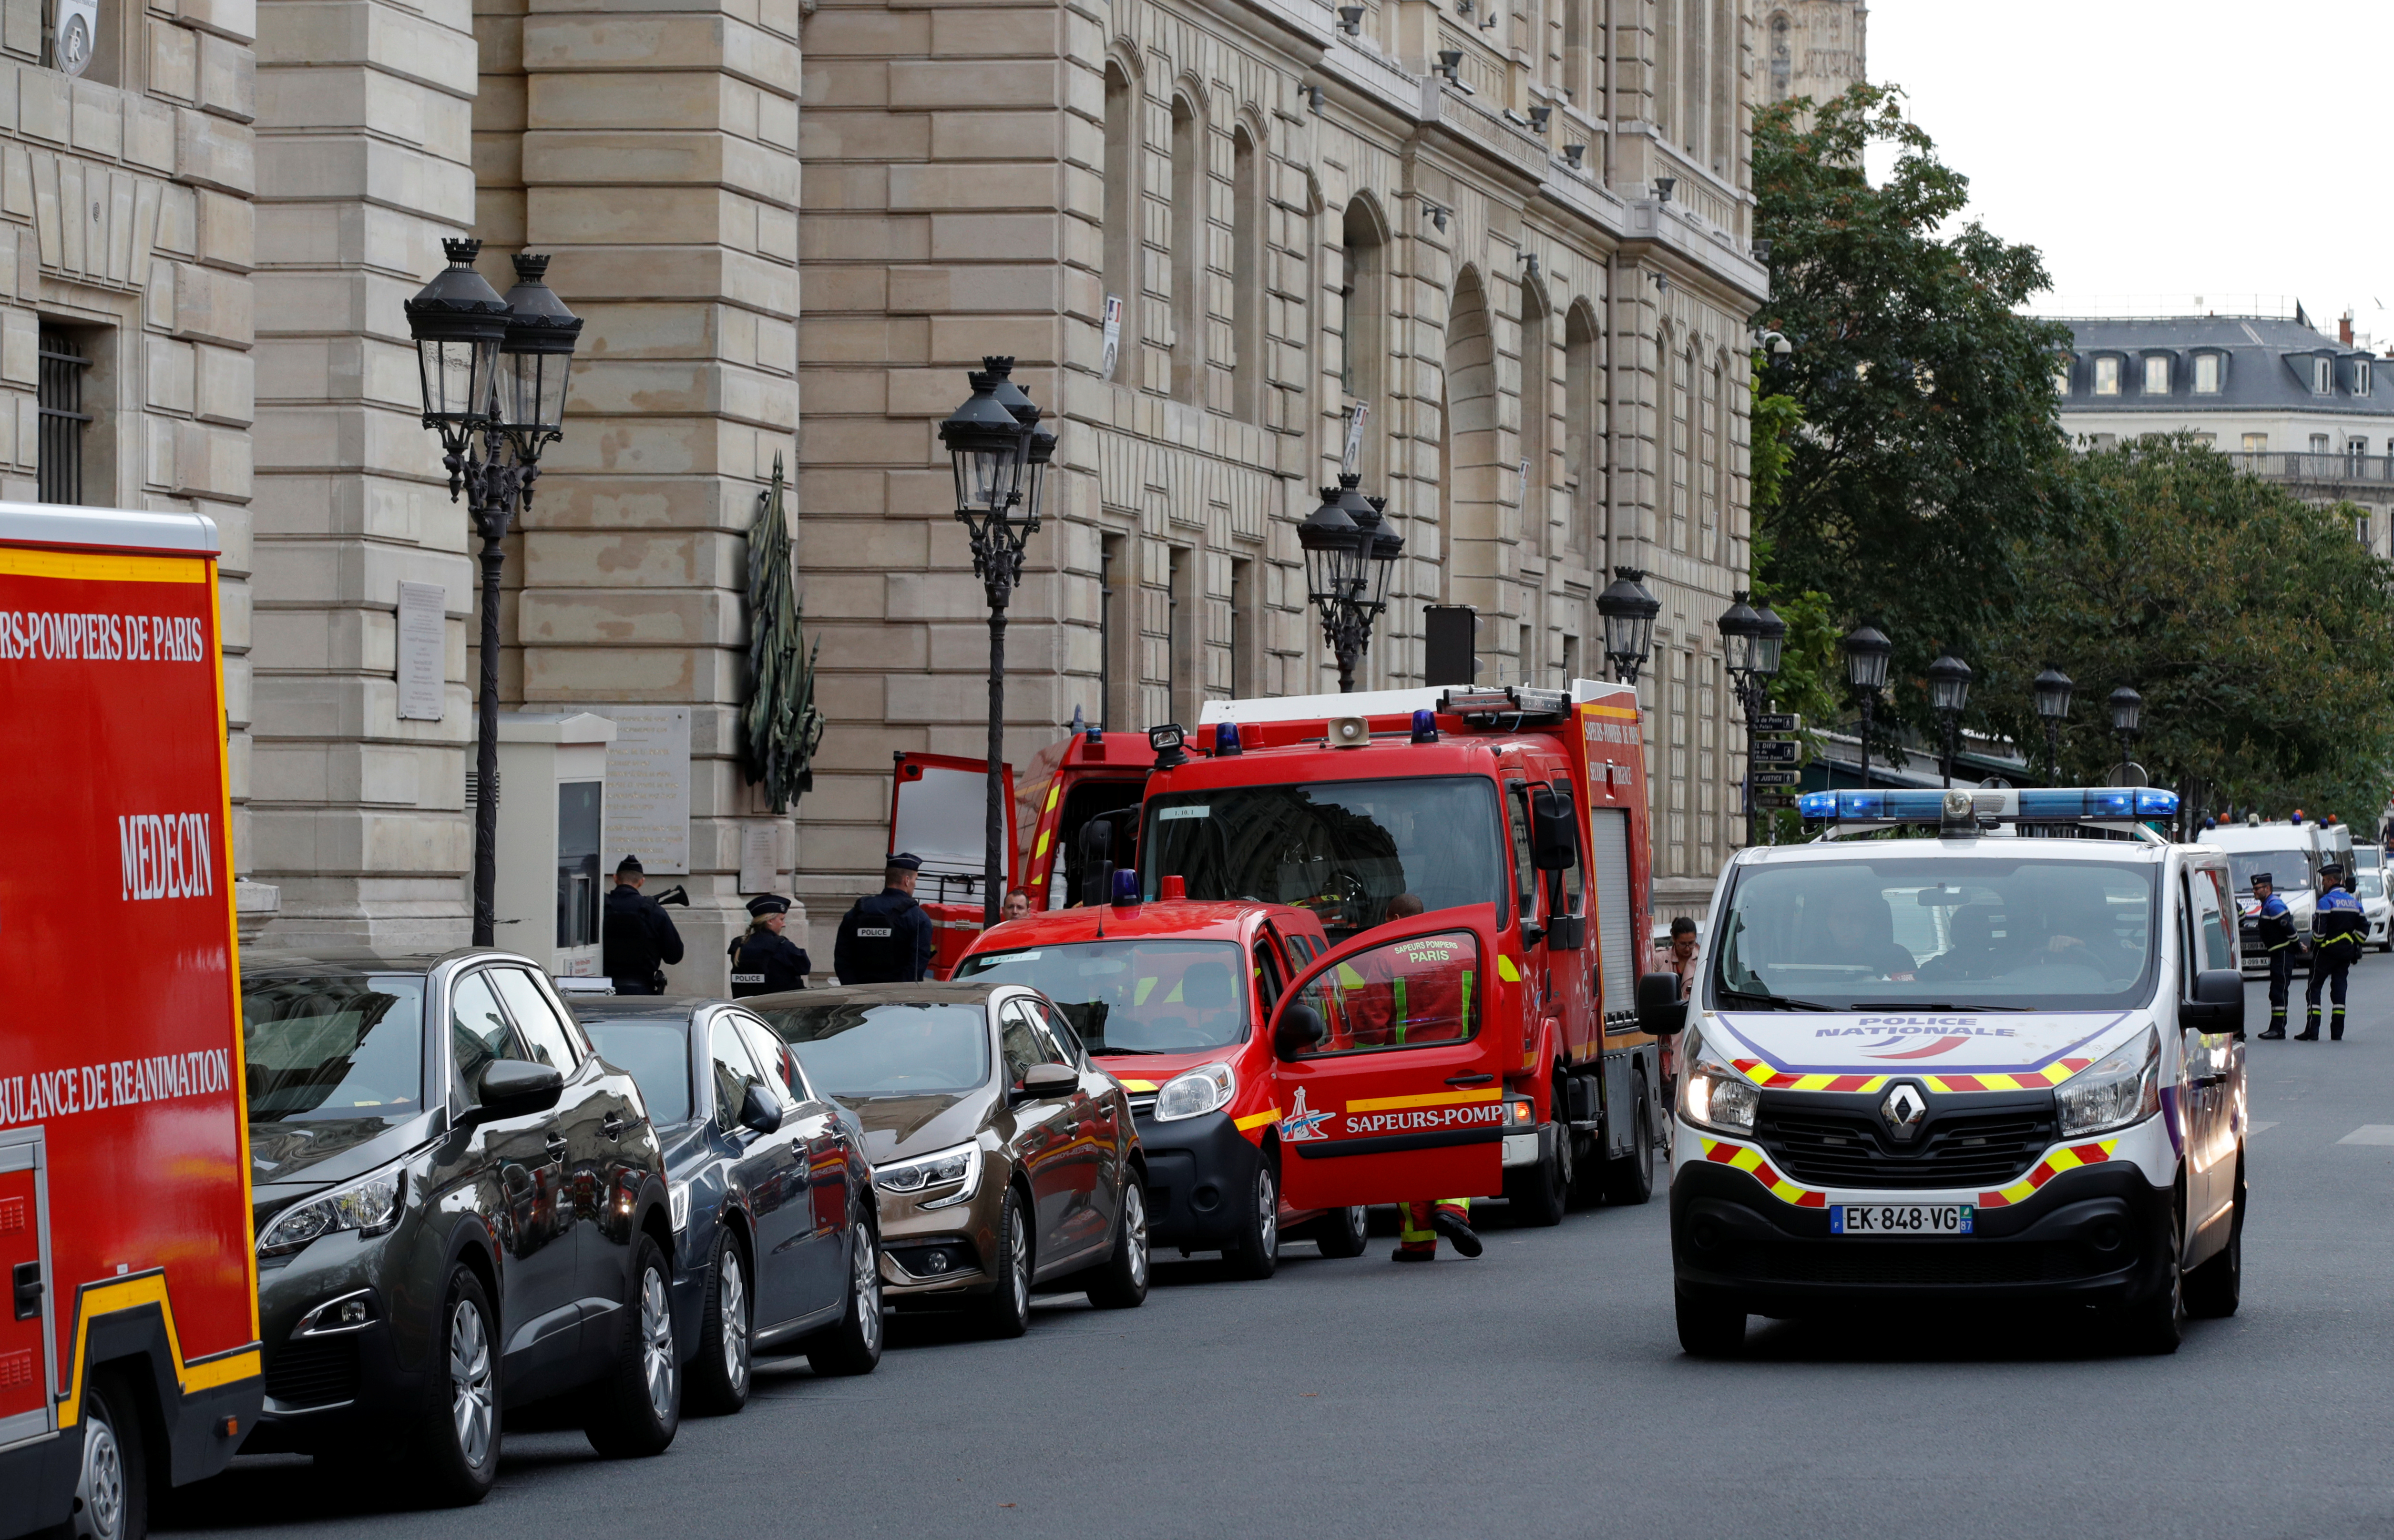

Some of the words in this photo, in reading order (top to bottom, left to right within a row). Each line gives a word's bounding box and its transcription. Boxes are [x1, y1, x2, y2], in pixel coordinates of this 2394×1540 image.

[0, 611, 122, 660] RS-POMPIERS
[125, 615, 150, 661] DE
[152, 616, 203, 663] PARIS
[1585, 722, 1622, 744] SAPEURS-POMPIERS
[1622, 725, 1629, 744] DE
[1629, 726, 1638, 745] PARIS
[119, 812, 212, 901] MEDECIN
[2336, 899, 2356, 908] POLICE
[1394, 942, 1425, 954] SAPEURS
[1425, 941, 1458, 949] POMPIERS
[1409, 950, 1450, 963] PARIS
[1815, 1027, 2015, 1037] NATIONALE
[82, 1064, 108, 1111] DE
[111, 1048, 229, 1106] REANIMATION
[1347, 1105, 1502, 1133] SAPEURS-POMP
[1847, 1207, 1957, 1230] EK-848-VG
[1961, 1221, 1972, 1230] 87
